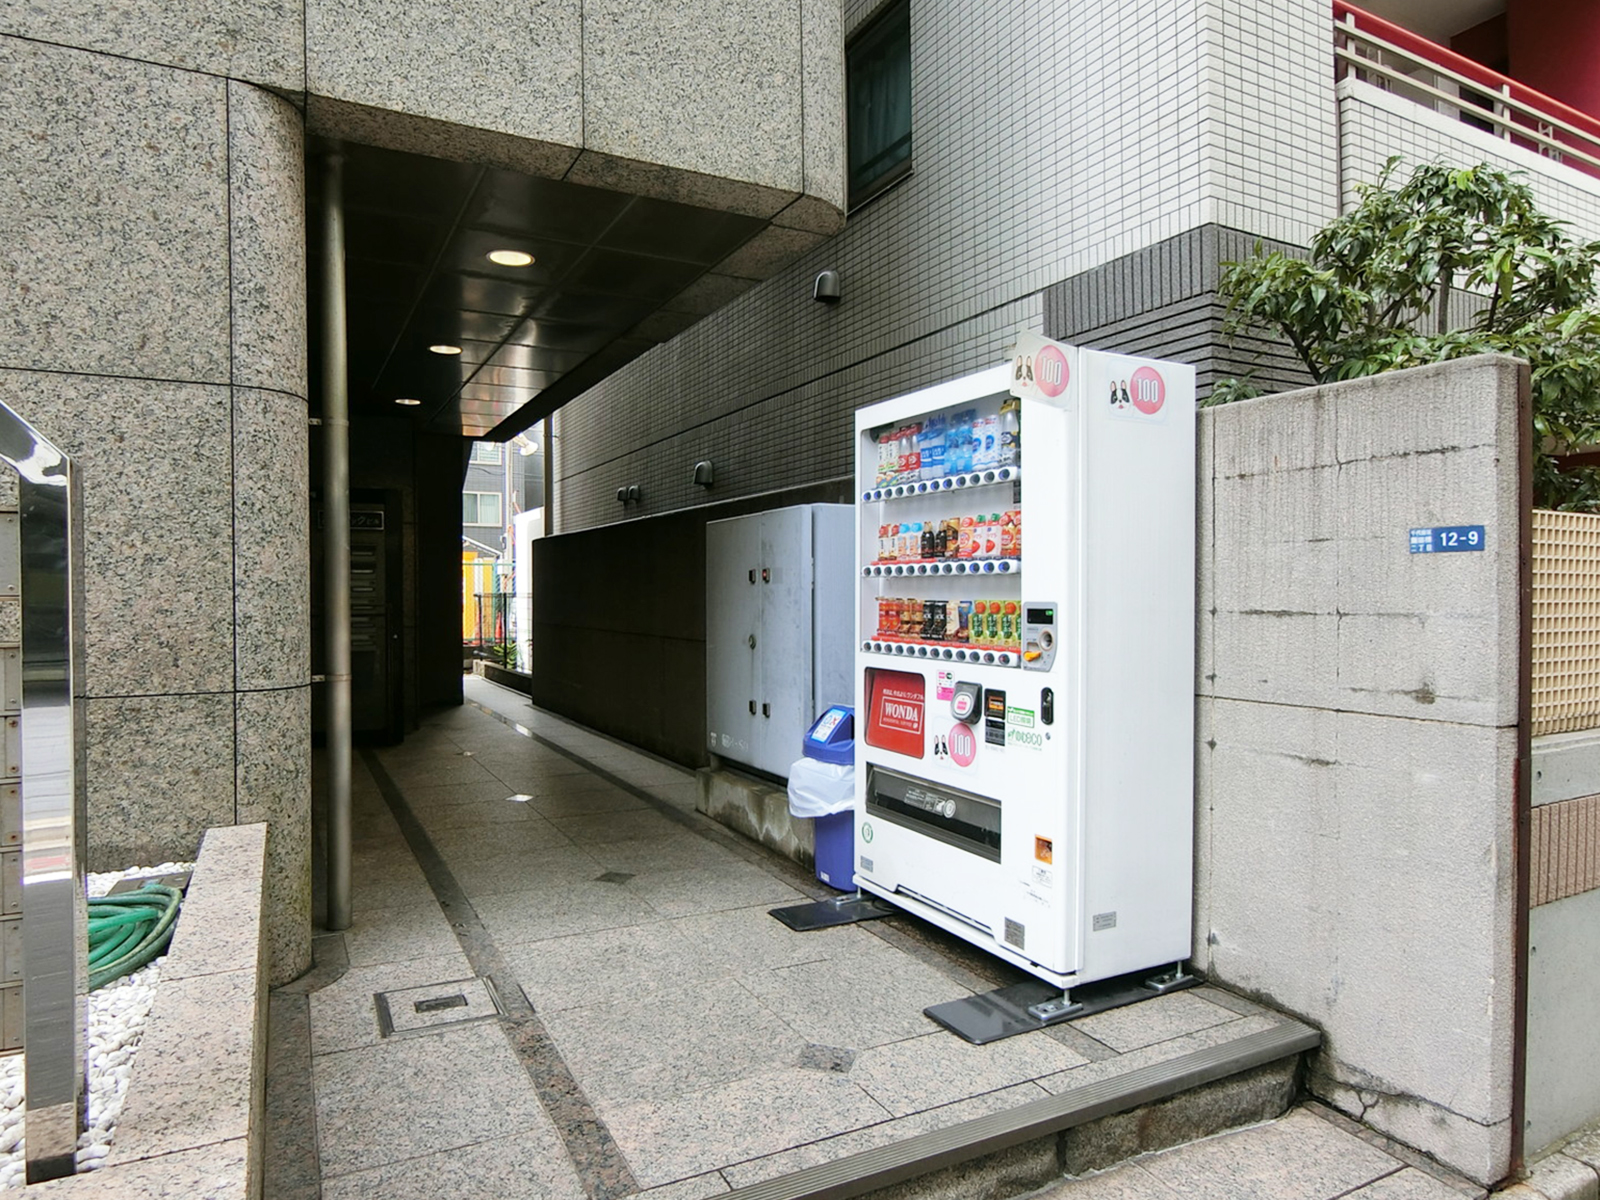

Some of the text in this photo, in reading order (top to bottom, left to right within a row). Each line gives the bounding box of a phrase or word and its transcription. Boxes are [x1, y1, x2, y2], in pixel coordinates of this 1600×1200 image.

[1041, 356, 1063, 386] 100
[1136, 378, 1159, 403] 100
[1440, 531, 1479, 547] 12-9
[885, 702, 918, 721] WONDA
[953, 734, 971, 757] 100
